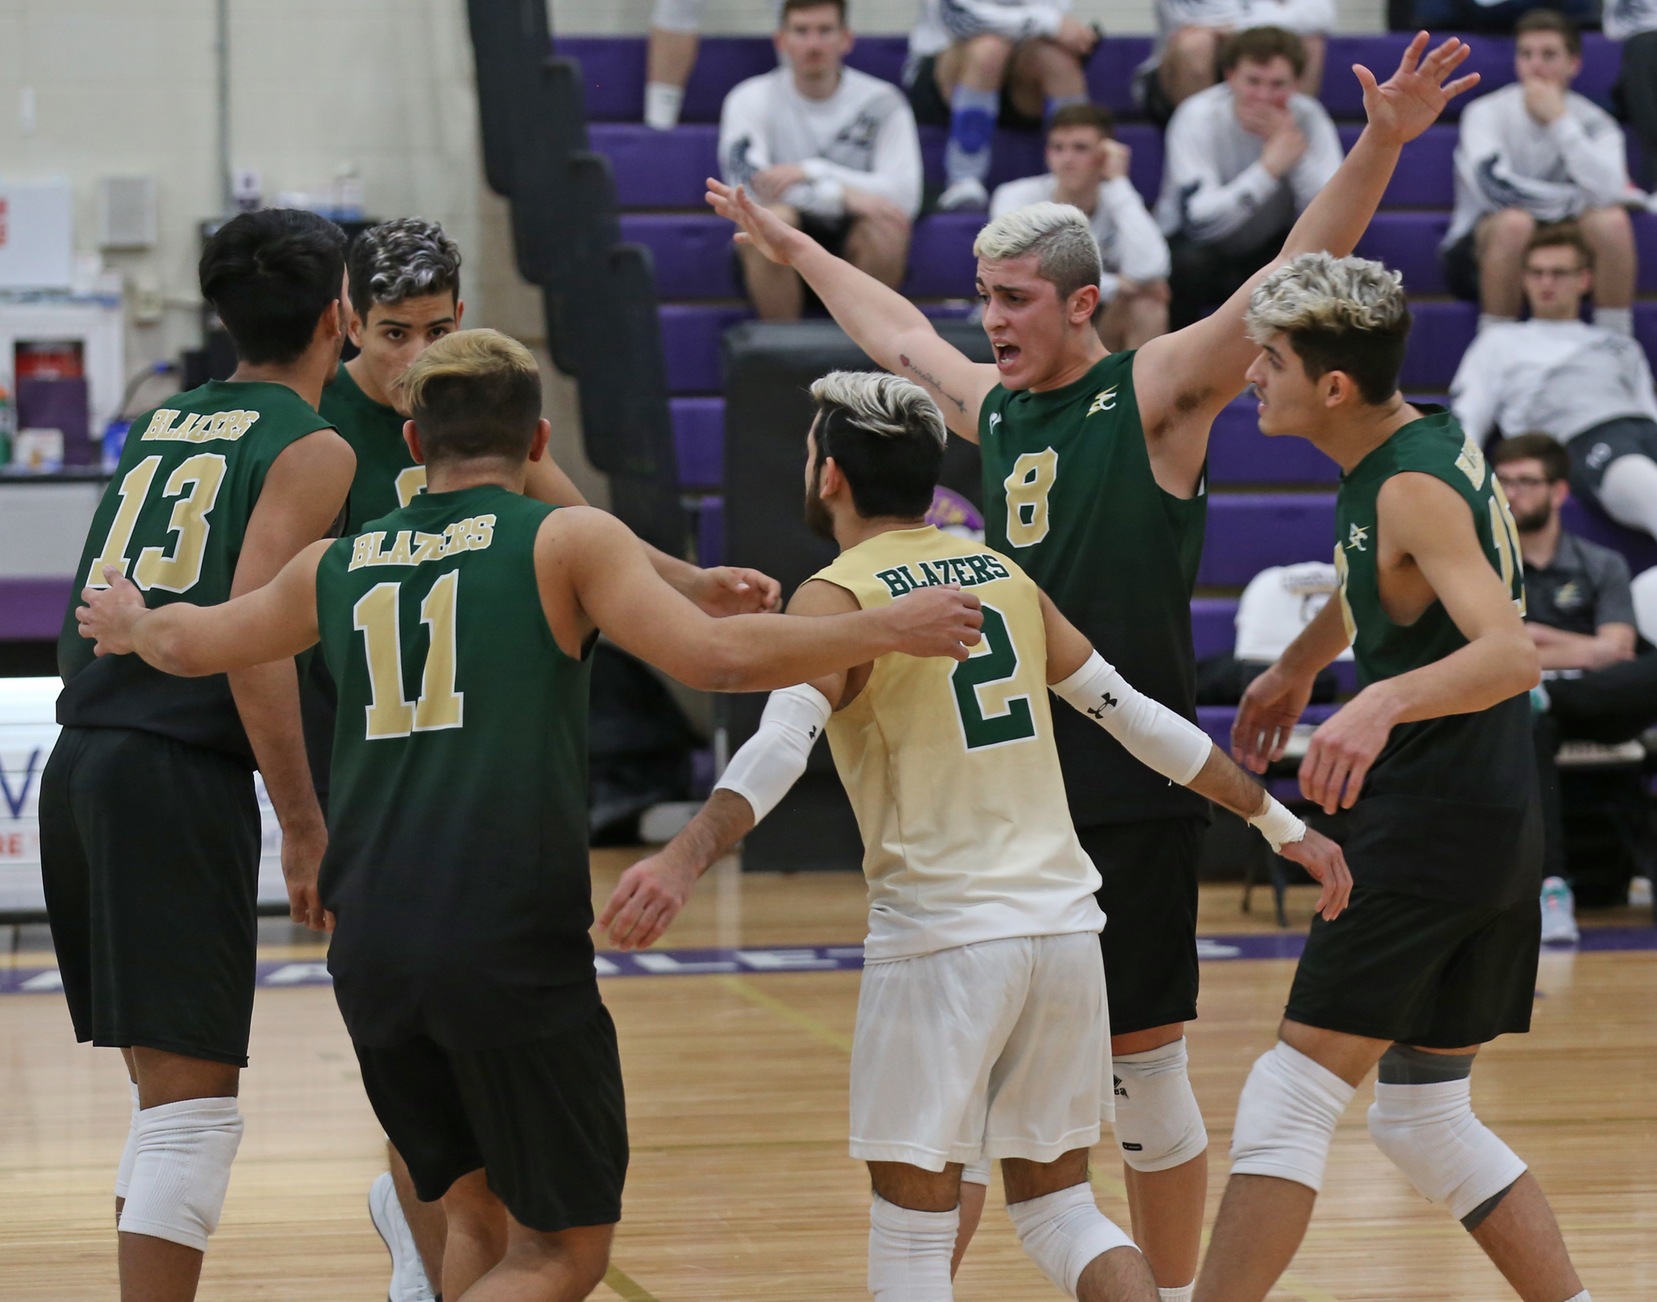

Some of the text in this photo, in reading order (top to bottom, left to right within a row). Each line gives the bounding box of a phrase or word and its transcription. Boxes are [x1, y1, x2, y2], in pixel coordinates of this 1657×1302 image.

[141, 409, 260, 443] BLAZERS
[87, 453, 228, 594] 13
[348, 514, 497, 572] BLAZERS
[1004, 446, 1058, 548] 8
[874, 553, 1011, 599] BLAZERS
[353, 569, 463, 740] 11
[948, 602, 1038, 753] 2
